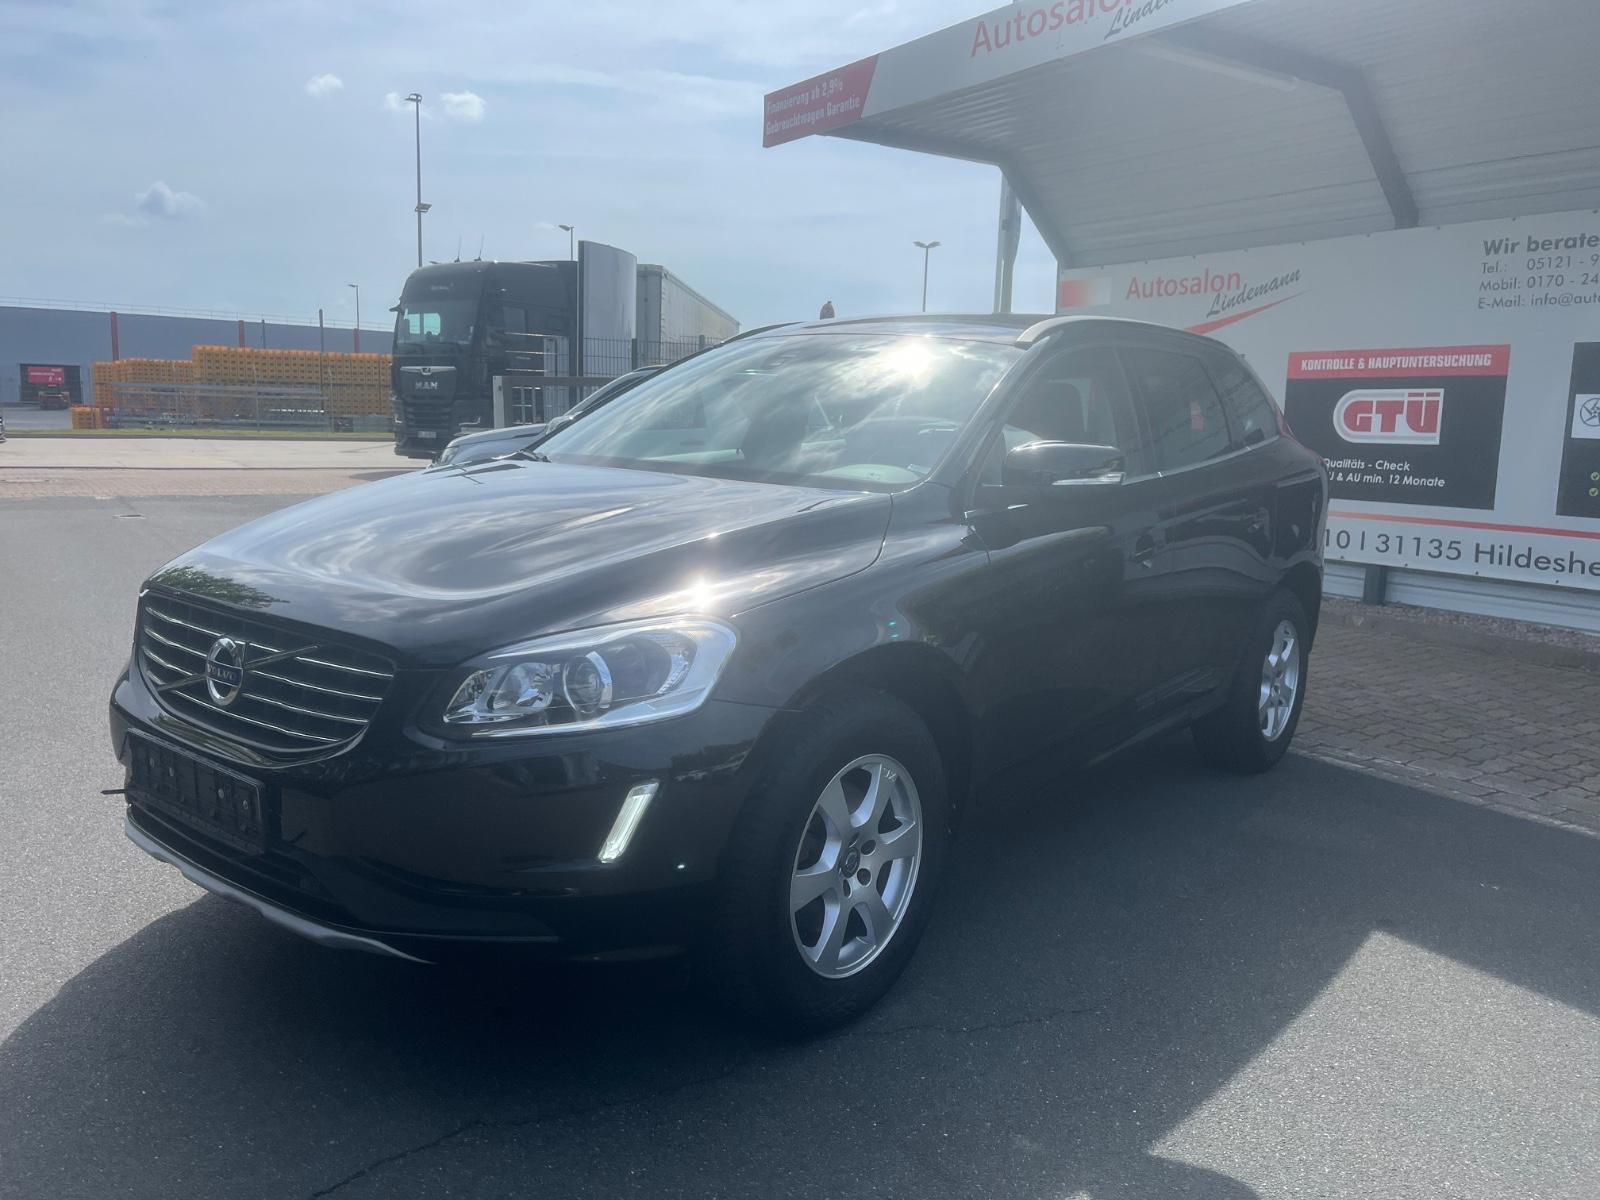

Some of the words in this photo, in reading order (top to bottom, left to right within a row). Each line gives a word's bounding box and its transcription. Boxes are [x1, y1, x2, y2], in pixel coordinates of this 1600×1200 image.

[826, 94, 860, 117] Garantie
[1483, 238, 1520, 256] Wir
[1527, 255, 1571, 270] 05121
[1126, 268, 1241, 300] Autosalon
[1479, 276, 1521, 291] Mobil:
[1527, 274, 1564, 288] 0170
[1206, 268, 1301, 318] Lindemann
[1478, 294, 1525, 309] E-Mail:
[1301, 358, 1354, 371] KONTROLLE
[1357, 358, 1365, 369] &
[1368, 354, 1492, 369] HAUPTUNTERSUCHUNG
[415, 381, 438, 390] MAN
[1344, 392, 1441, 433] GTÜ
[1375, 460, 1410, 472] Check
[1336, 472, 1344, 481] &
[1346, 473, 1361, 482] AU
[1363, 474, 1384, 484] min.
[1388, 474, 1400, 485] 12
[1402, 475, 1446, 487] Monate
[1375, 533, 1462, 561] 31135
[1474, 543, 1600, 577] Hildeshe
